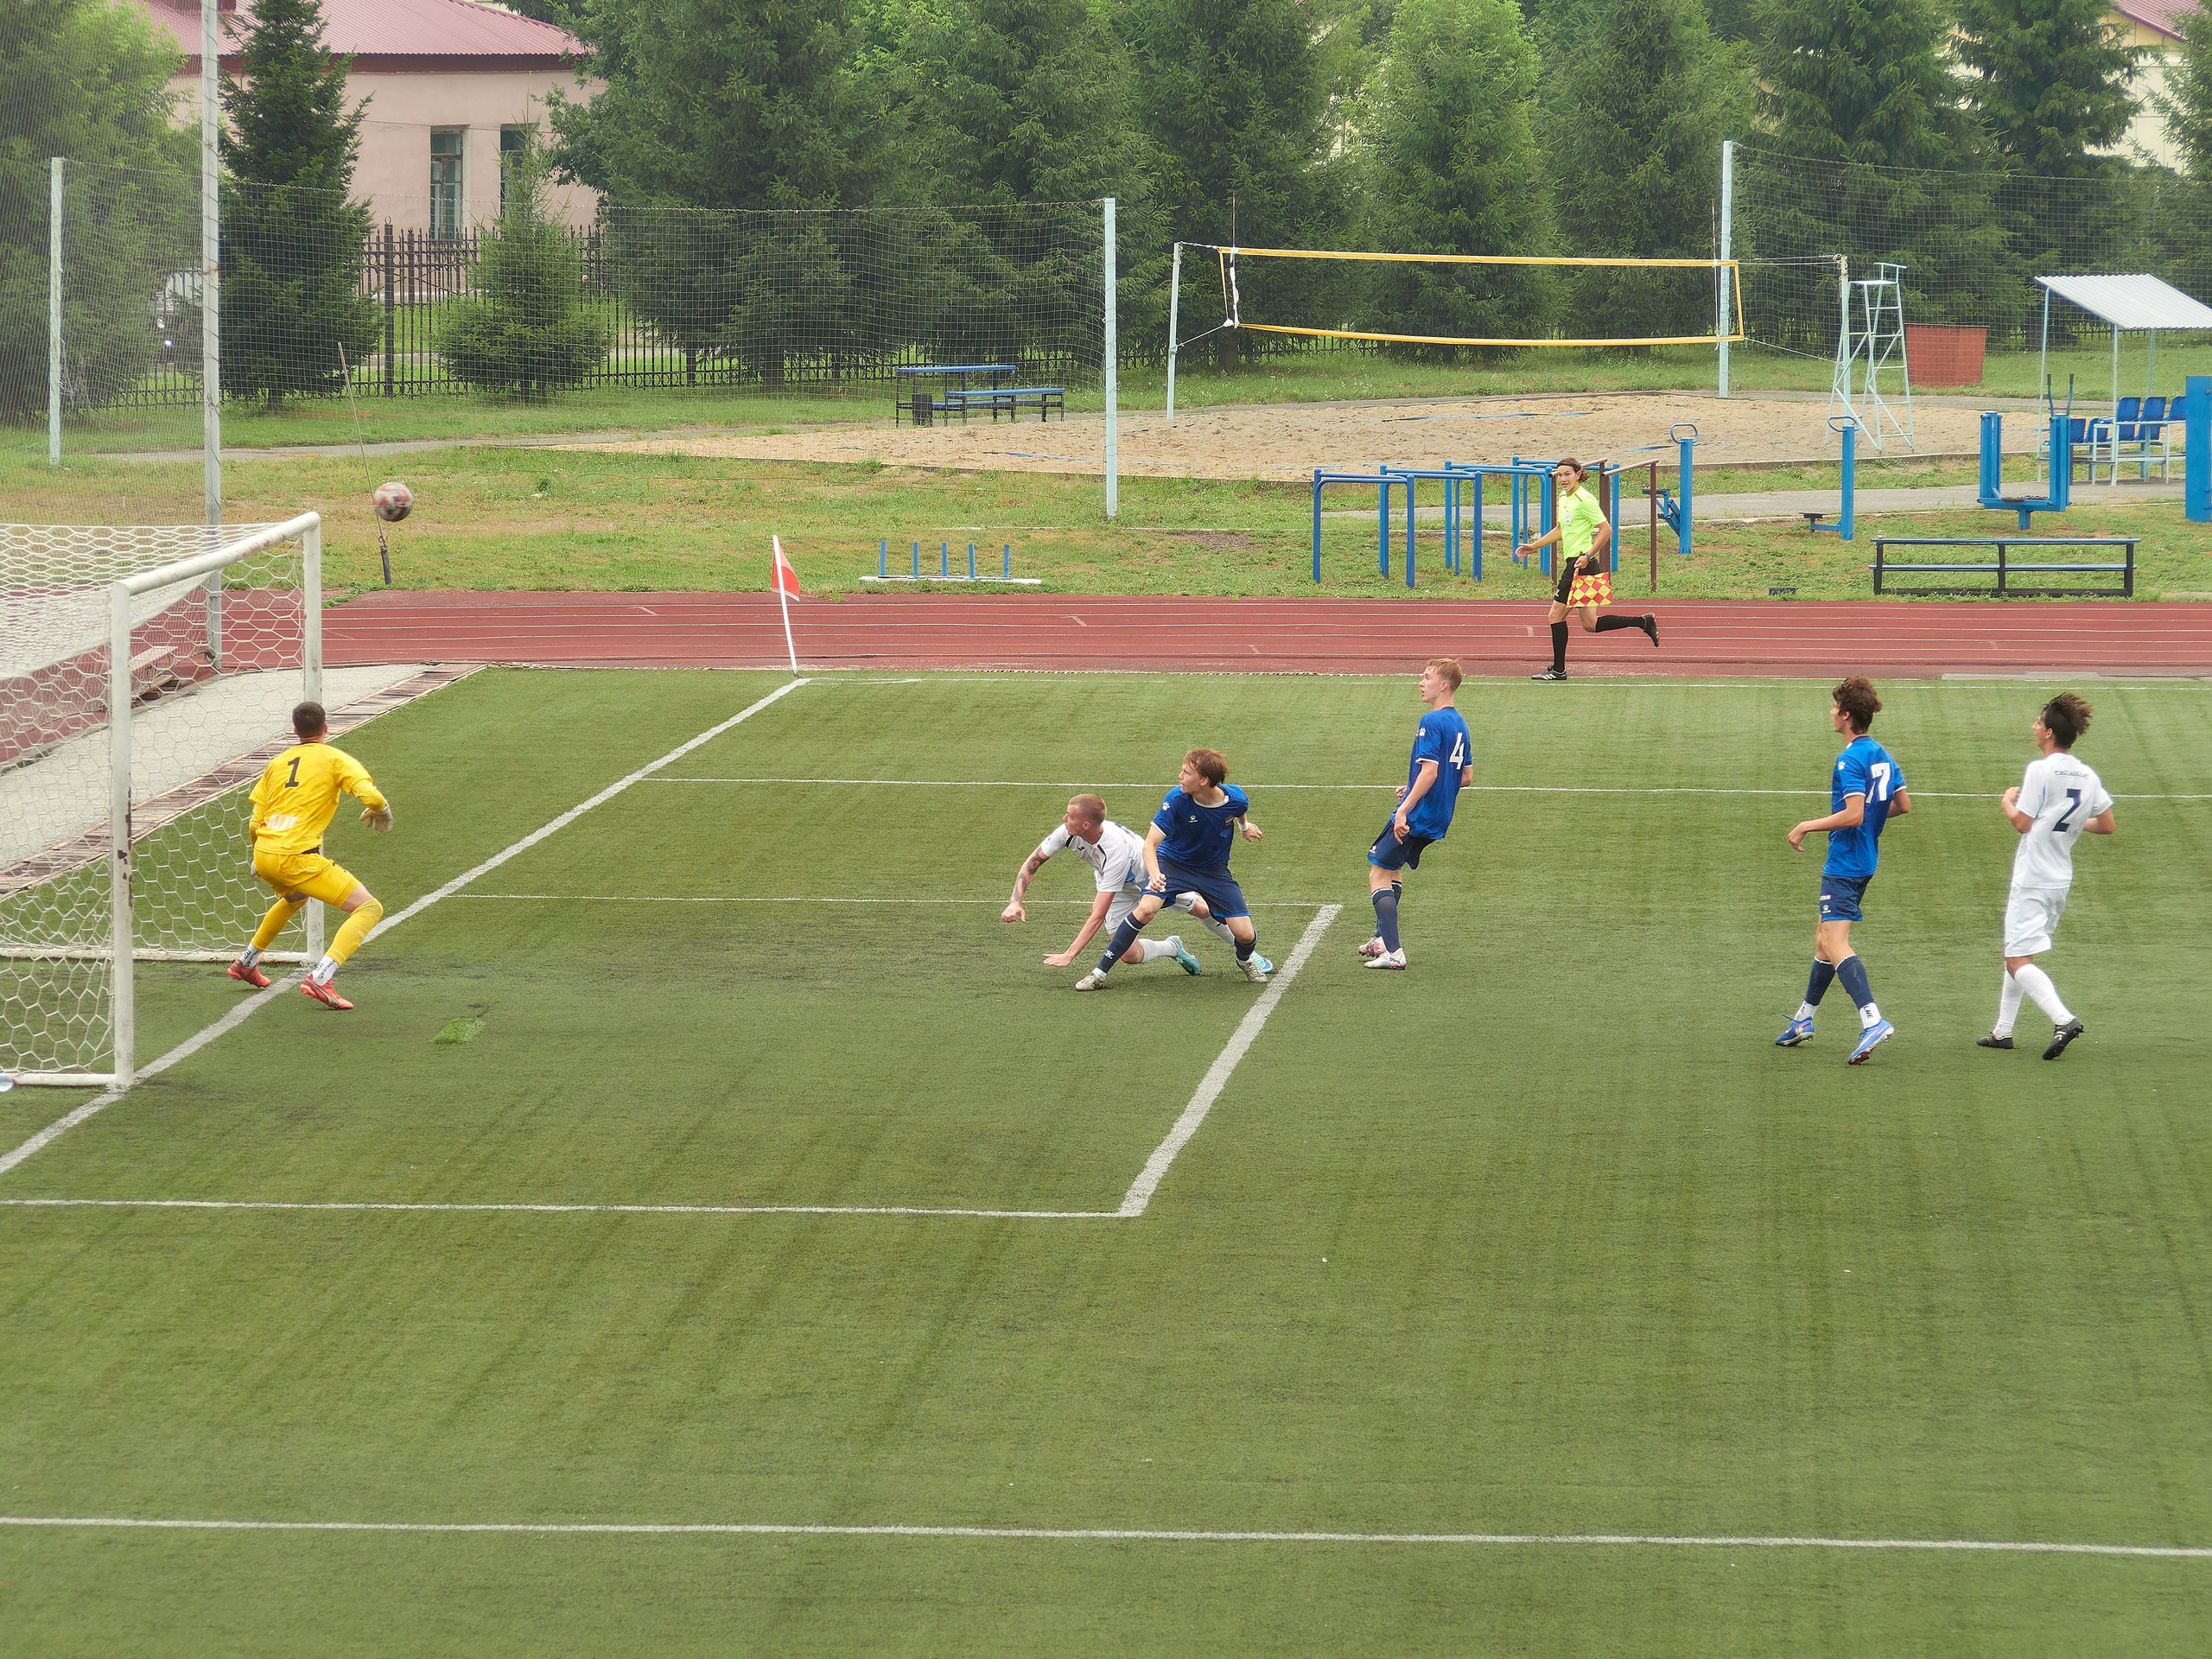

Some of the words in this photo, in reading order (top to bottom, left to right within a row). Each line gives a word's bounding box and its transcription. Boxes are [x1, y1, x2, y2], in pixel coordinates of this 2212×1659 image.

[1448, 732, 1465, 770] 4
[284, 756, 302, 788] 1
[2051, 788, 2082, 833] 2
